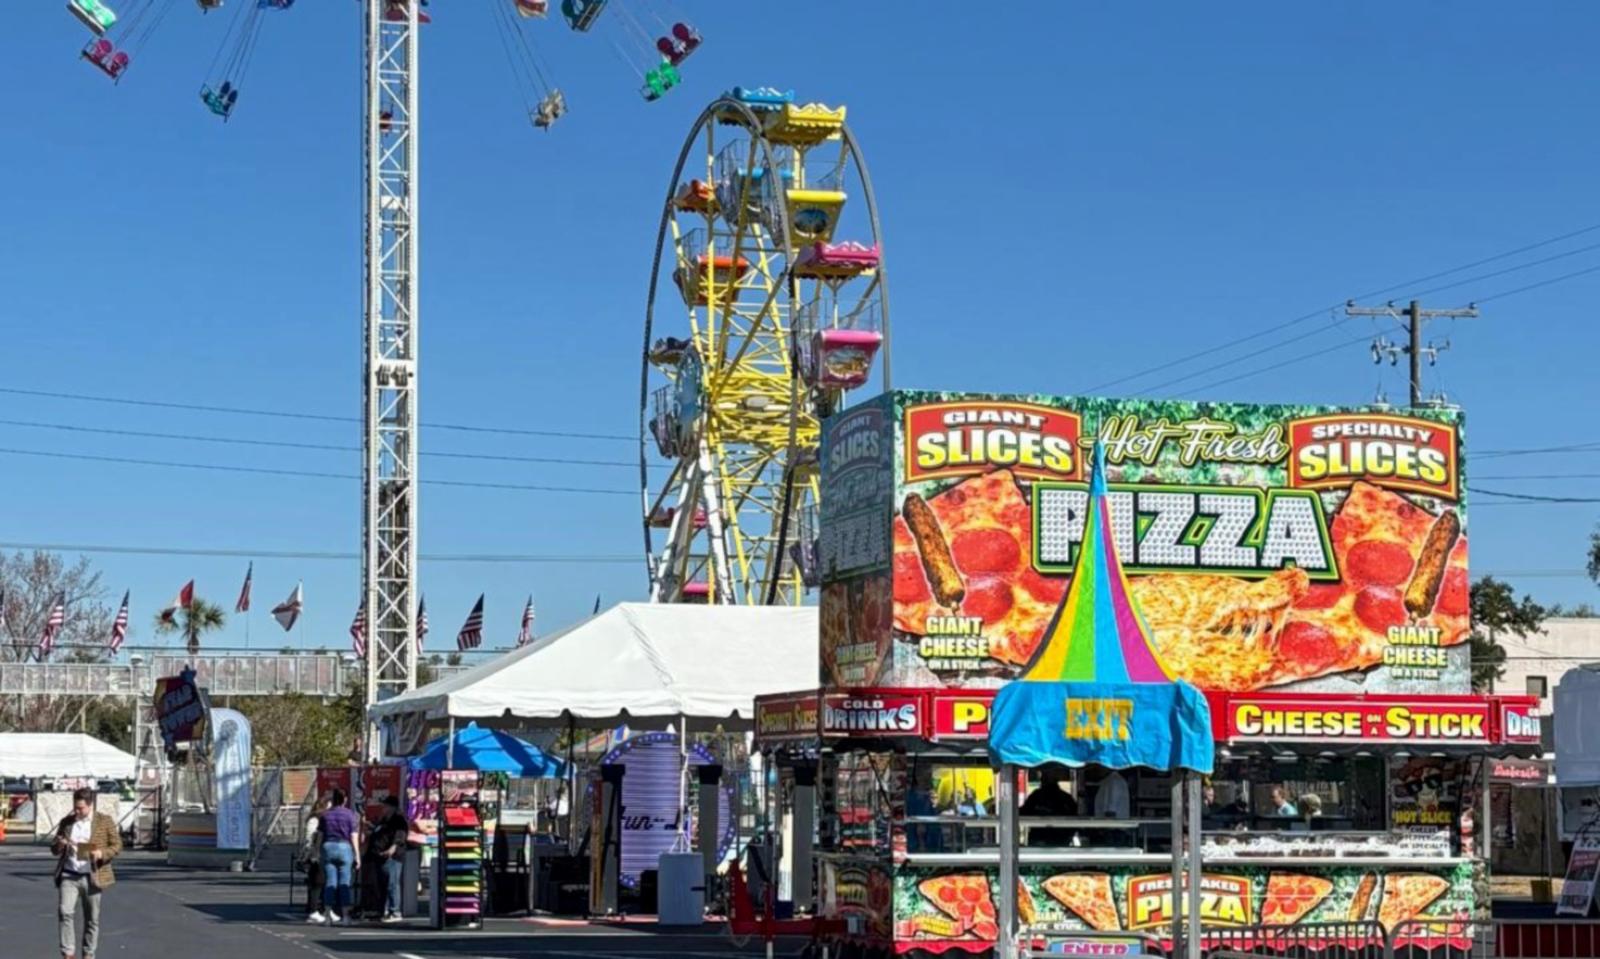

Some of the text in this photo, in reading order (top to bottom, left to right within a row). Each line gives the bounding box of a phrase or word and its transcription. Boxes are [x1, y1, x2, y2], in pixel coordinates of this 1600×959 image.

[838, 415, 873, 438] GIANT
[942, 409, 1047, 427] GIANT
[1078, 415, 1289, 468] Hot Fresh
[1311, 422, 1433, 443] SPECIALTY
[830, 429, 880, 474] SLICES
[916, 428, 1074, 474] SLICES
[1298, 440, 1448, 485] SLICES
[1038, 487, 1330, 571] PIZZA
[925, 616, 983, 635] GIANT
[1387, 625, 1441, 646] GIANT
[918, 636, 990, 658] CHEESE
[1382, 646, 1448, 667] CHEESE
[824, 702, 917, 731] DRINKS
[842, 699, 885, 710] COLD
[952, 701, 992, 732] P
[1064, 697, 1134, 740] EXIT
[1235, 703, 1362, 736] CHEESE
[1370, 726, 1378, 735] A
[1385, 705, 1485, 739] STICK
[1198, 876, 1241, 893] AKED
